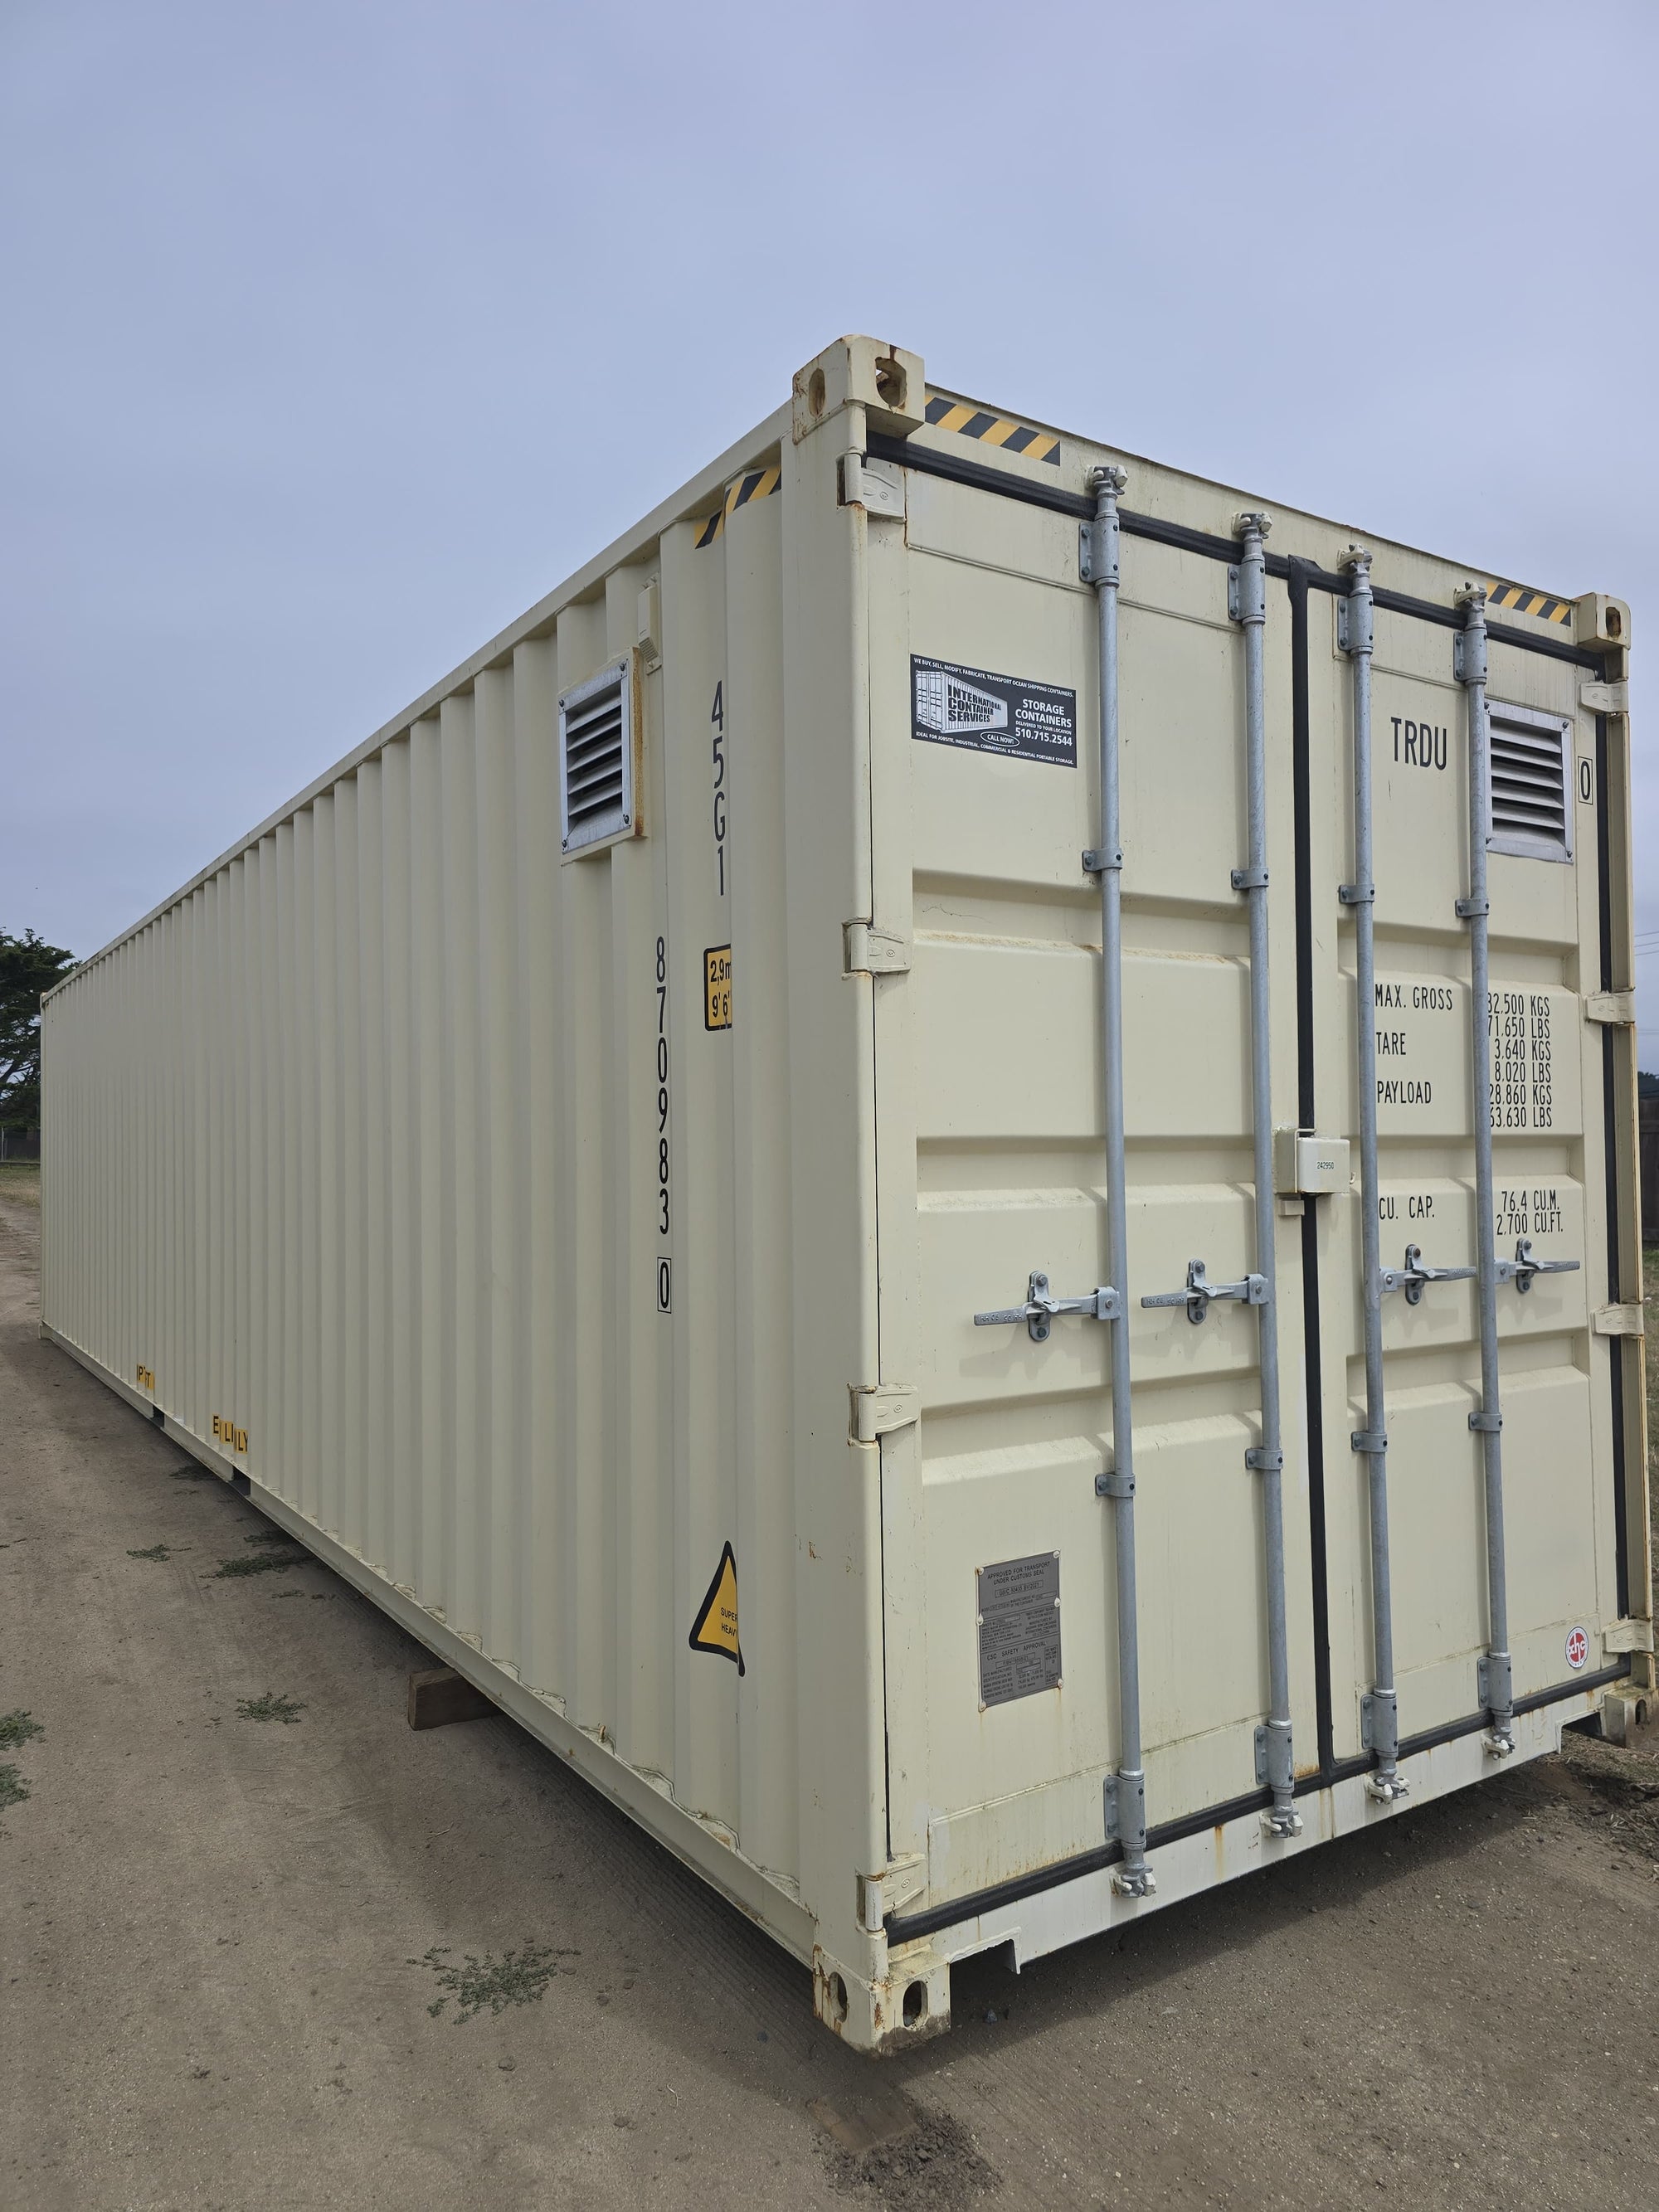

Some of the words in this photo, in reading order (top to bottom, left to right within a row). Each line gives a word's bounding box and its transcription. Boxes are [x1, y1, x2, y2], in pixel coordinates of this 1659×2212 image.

[944, 664, 962, 673] MODIFY,
[987, 674, 1012, 684] TRANSPORT
[1028, 683, 1047, 692] SHIPPING
[947, 684, 1001, 711] INTERNATIONAL
[947, 697, 994, 715] CONTAINER
[1023, 698, 1064, 716] STORAGE
[947, 709, 990, 722] SERVICES
[1015, 709, 1072, 728] CONTAINERS
[1015, 720, 1036, 728] DELIVERED
[1000, 737, 1014, 745] NOW!
[1015, 727, 1073, 746] 510.715.2544
[1390, 717, 1447, 771] TRDU
[980, 744, 1007, 753] COMMERCIAL
[1011, 750, 1035, 758] RESIDENTIAL
[1036, 753, 1055, 761] PORTABLE
[711, 679, 726, 897] 45G1
[1374, 984, 1407, 1009] MAX.
[1413, 986, 1452, 1010] GROSS
[1530, 995, 1550, 1017] KGS
[1487, 1015, 1525, 1038] 71,650
[1531, 1017, 1550, 1038] LBS
[1375, 1032, 1407, 1056] TARE
[1494, 1038, 1525, 1061] 3,640
[1531, 1039, 1551, 1061] KGS
[1495, 1061, 1526, 1082] 8,020
[1532, 1062, 1551, 1083] LBS
[1377, 1081, 1432, 1104] PAYLOAD
[1532, 1084, 1552, 1106] KGS
[1533, 1107, 1552, 1128] LBS
[1379, 1197, 1399, 1220] CU.
[1408, 1195, 1435, 1218] CAP.
[1501, 1190, 1528, 1213] 76.4
[1533, 1189, 1559, 1212] CU.M.
[1496, 1213, 1528, 1236] 2,700
[987, 1569, 1012, 1579] APPROVED
[1024, 1561, 1050, 1571] TRANSPORT
[993, 1576, 1010, 1585] UNDER
[1010, 1573, 1032, 1581] CUSTOMS
[721, 1622, 737, 1637] HEAV
[1001, 1648, 1019, 1657] SAFETY
[1023, 1641, 1047, 1650] APPROVAL
